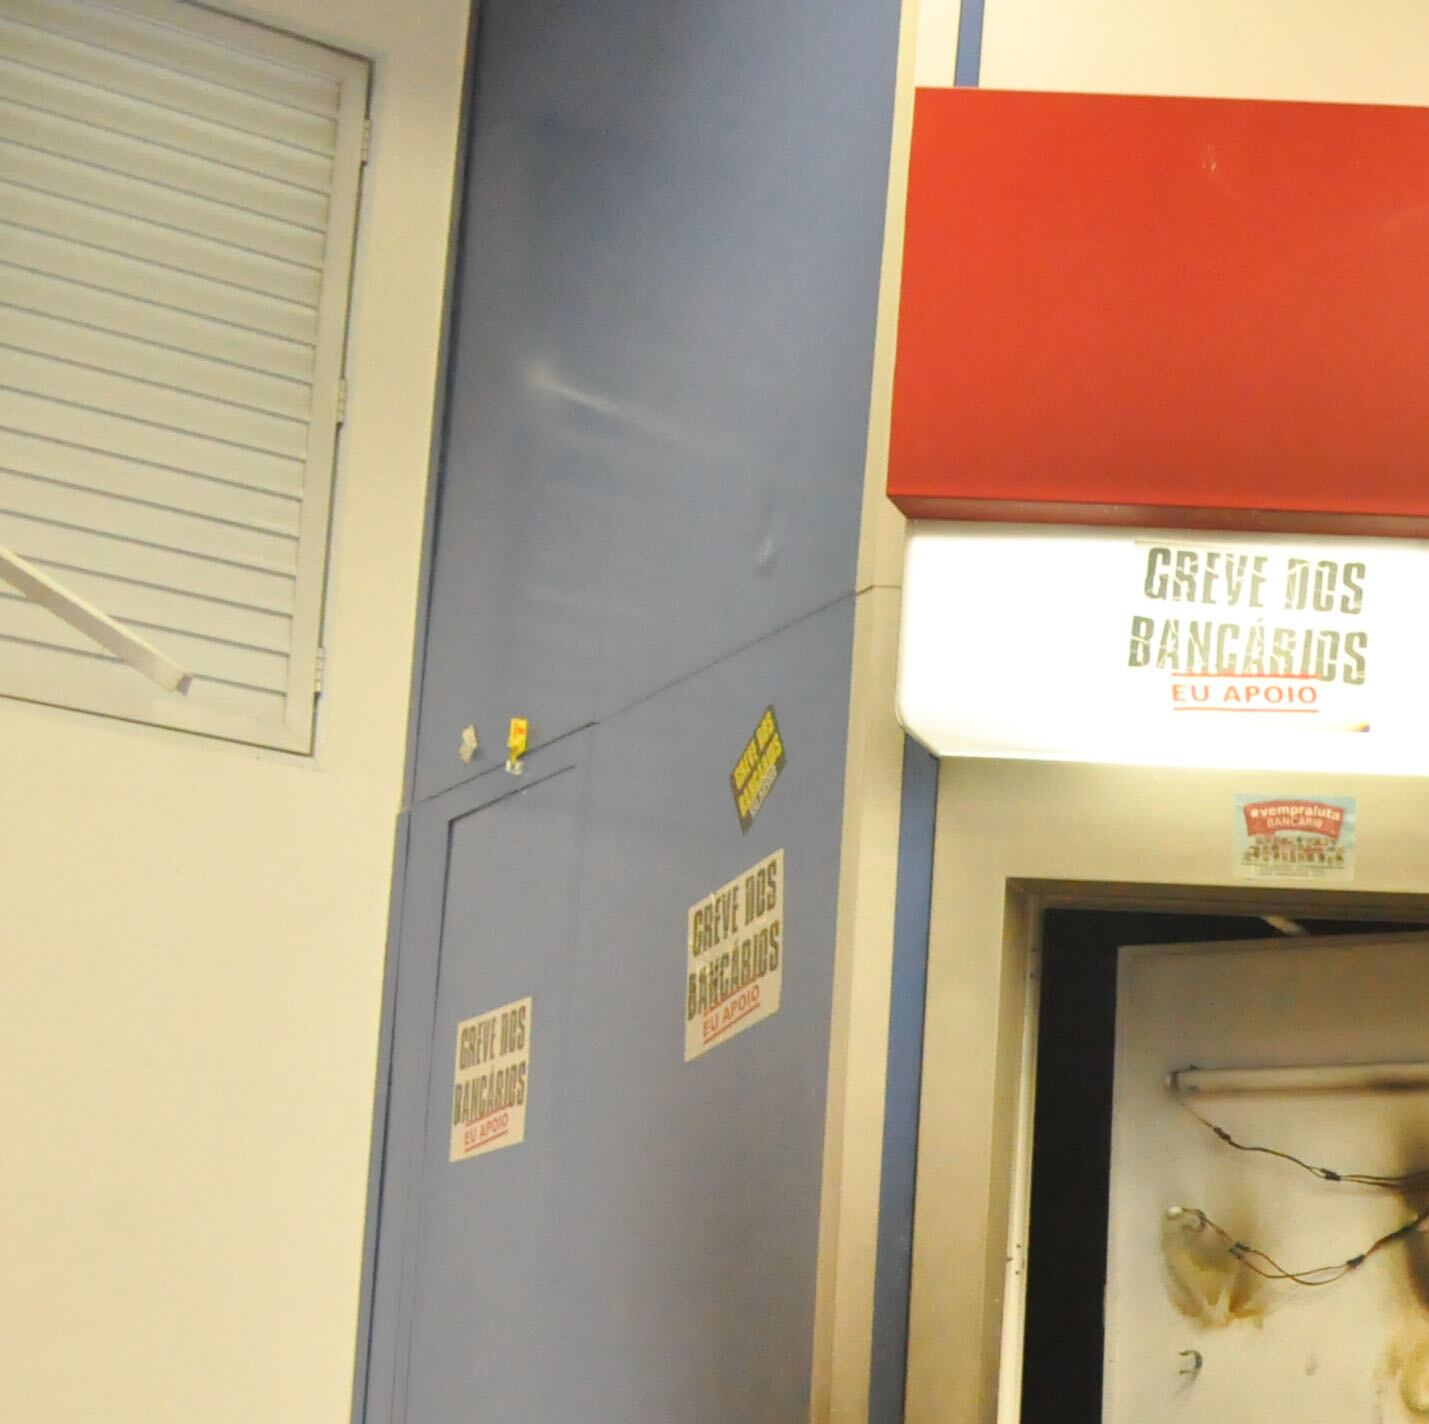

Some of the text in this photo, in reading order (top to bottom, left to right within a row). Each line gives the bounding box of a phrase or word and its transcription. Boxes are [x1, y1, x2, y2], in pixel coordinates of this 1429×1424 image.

[1144, 547, 1366, 615] GREVE DOS
[1127, 615, 1369, 686] BANCÁRIOS
[1171, 684, 1318, 705] EU APOIO
[692, 859, 777, 958] GREVE DOS
[703, 984, 761, 1038] EU APOIO
